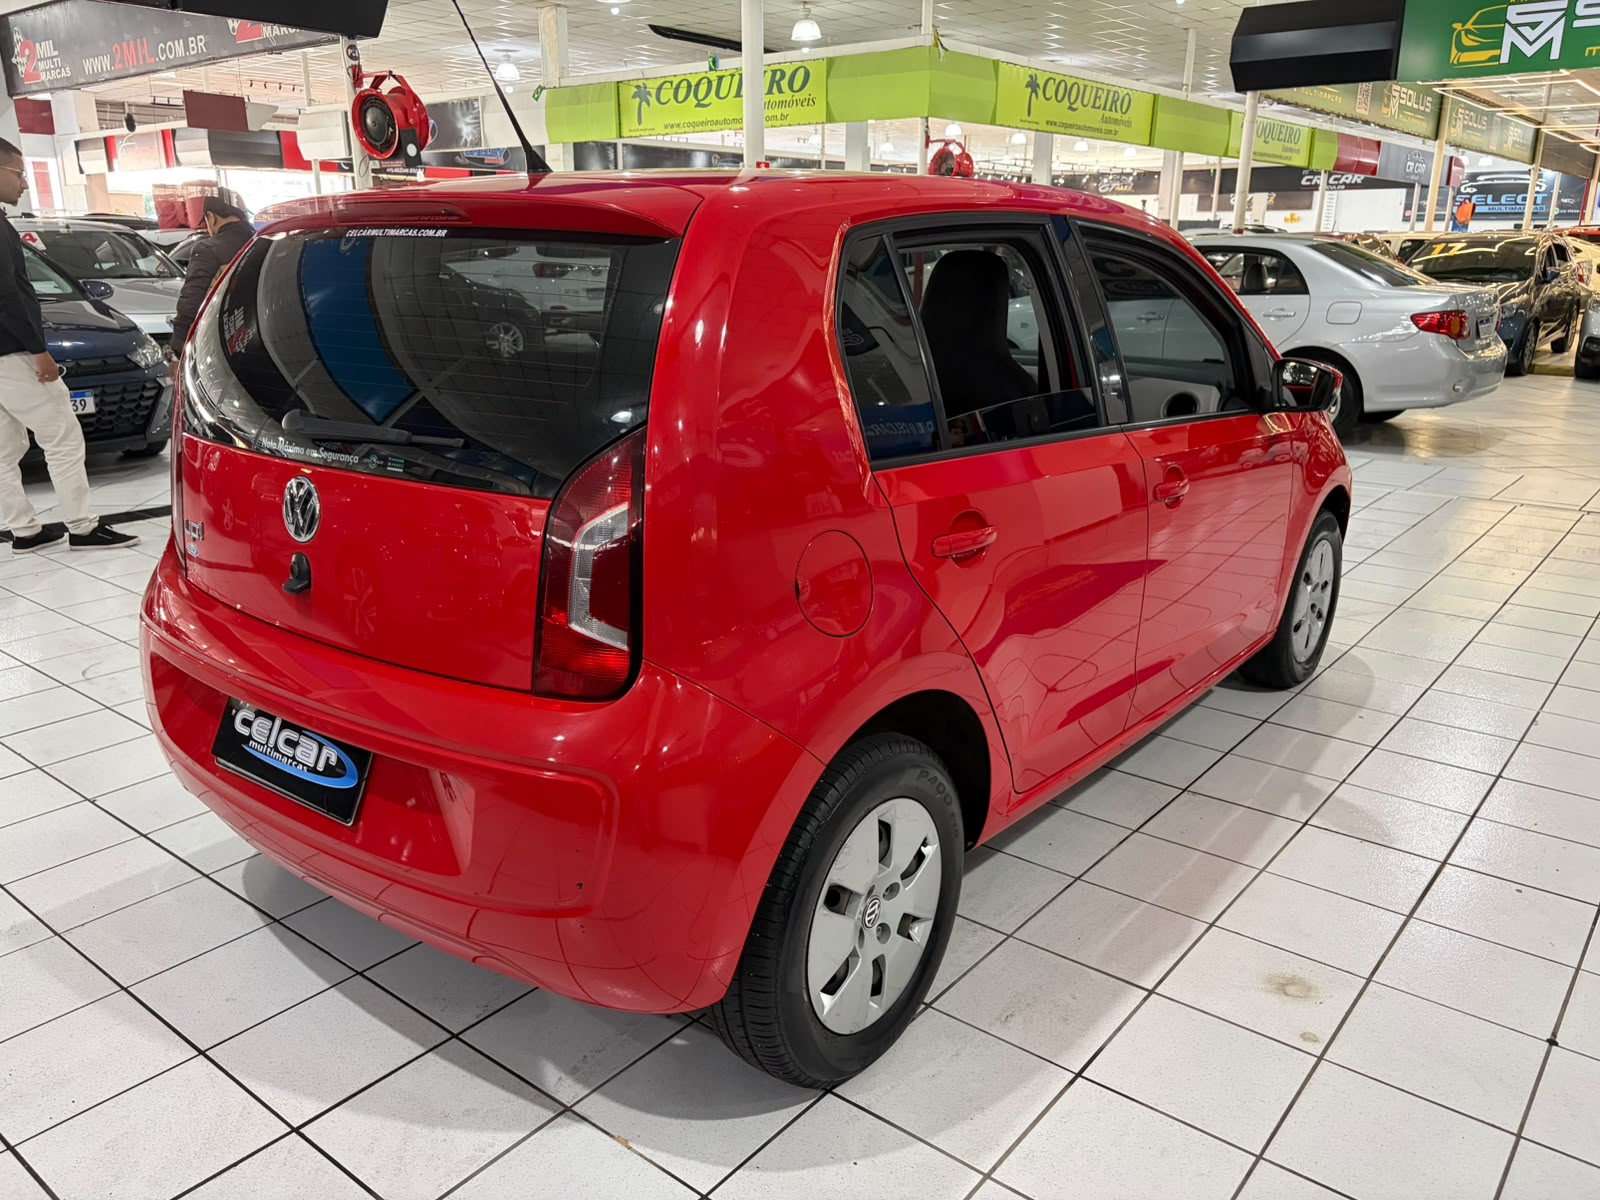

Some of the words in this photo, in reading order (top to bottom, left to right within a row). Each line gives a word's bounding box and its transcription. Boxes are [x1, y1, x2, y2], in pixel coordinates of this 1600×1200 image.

[35, 40, 59, 58] MIL
[82, 34, 207, 76] WWW.2MIL.COM.BR
[38, 57, 62, 69] MULTI
[40, 67, 72, 81] MARCAS
[1042, 76, 1132, 115] COQUEIRO
[1399, 87, 1432, 112] SOLUS
[1256, 120, 1301, 145] OQUEIRO
[1328, 173, 1365, 185] CAR
[1454, 194, 1547, 207] SELECT
[261, 437, 277, 449] Nota
[278, 437, 305, 454] Máxima
[320, 447, 359, 465] Segurança
[249, 740, 309, 773] multimarcas
